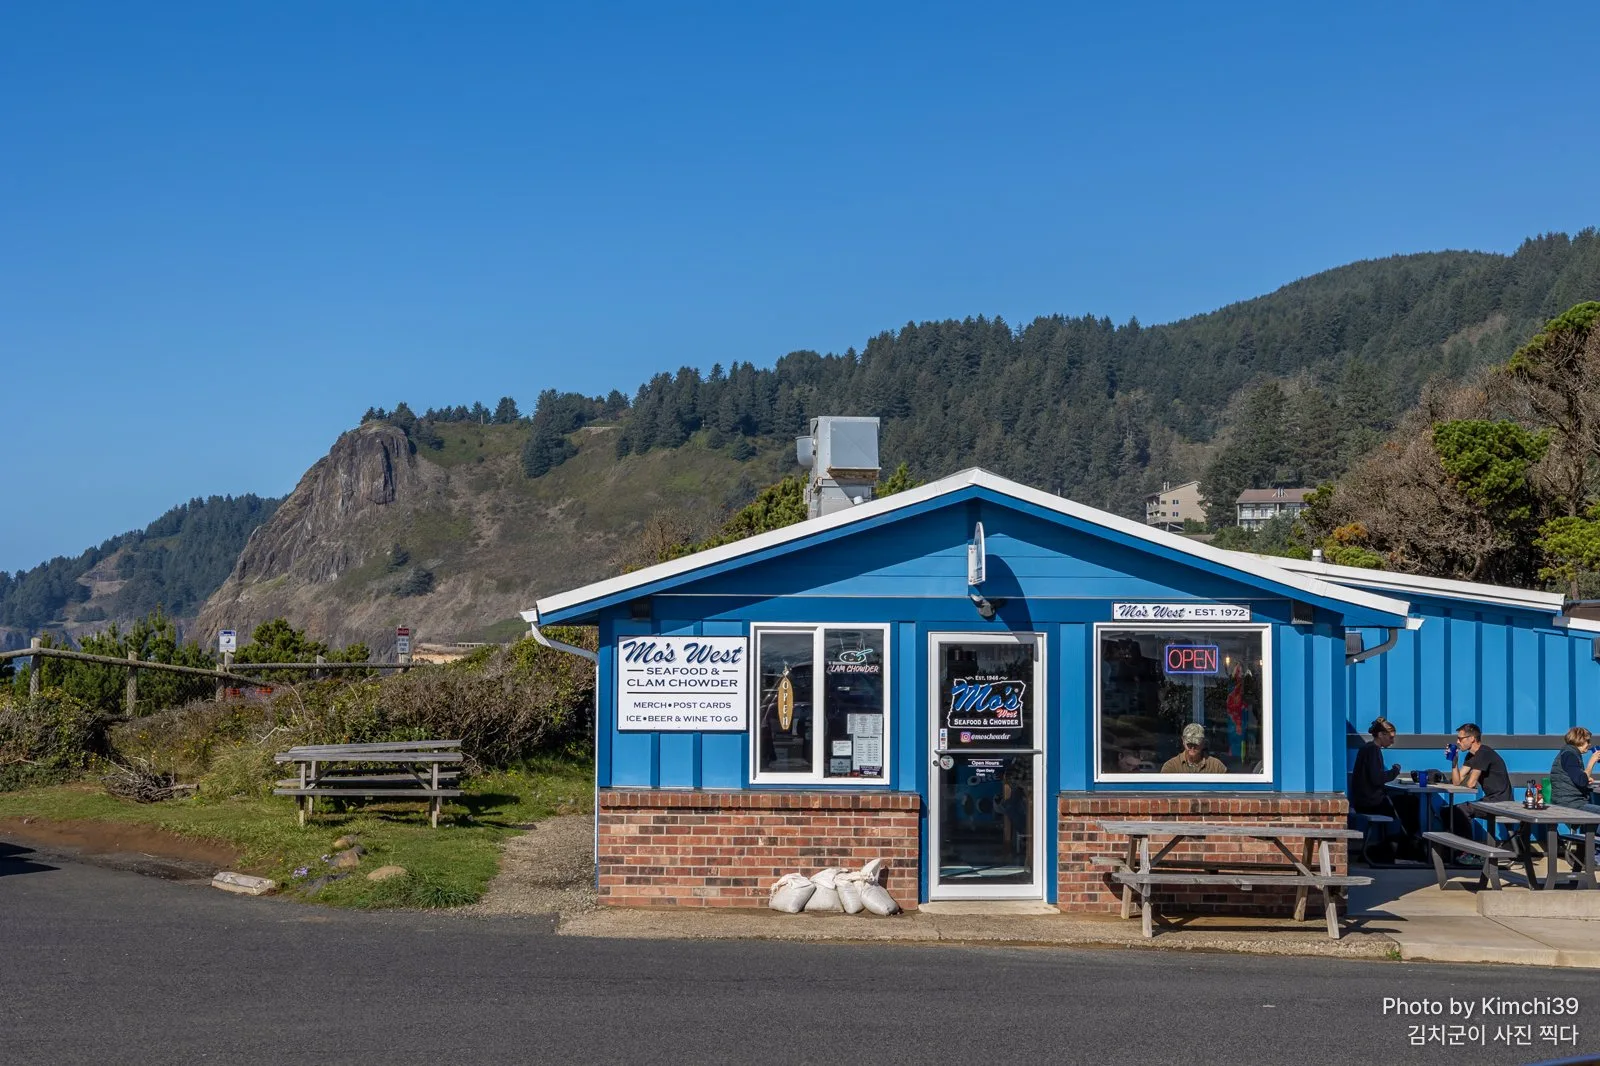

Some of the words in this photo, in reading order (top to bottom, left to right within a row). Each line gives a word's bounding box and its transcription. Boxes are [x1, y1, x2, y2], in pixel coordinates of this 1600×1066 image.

[1118, 604, 1148, 618] Mo's
[1152, 605, 1185, 618] West
[1220, 609, 1246, 617] 1972
[623, 641, 676, 664] Mo's
[684, 642, 743, 664] West
[1168, 649, 1217, 669] OPEN
[846, 664, 879, 674] CHOWDER
[627, 679, 665, 687] CLAM
[668, 679, 738, 687] CHOWDER
[951, 683, 1020, 712] Mo's
